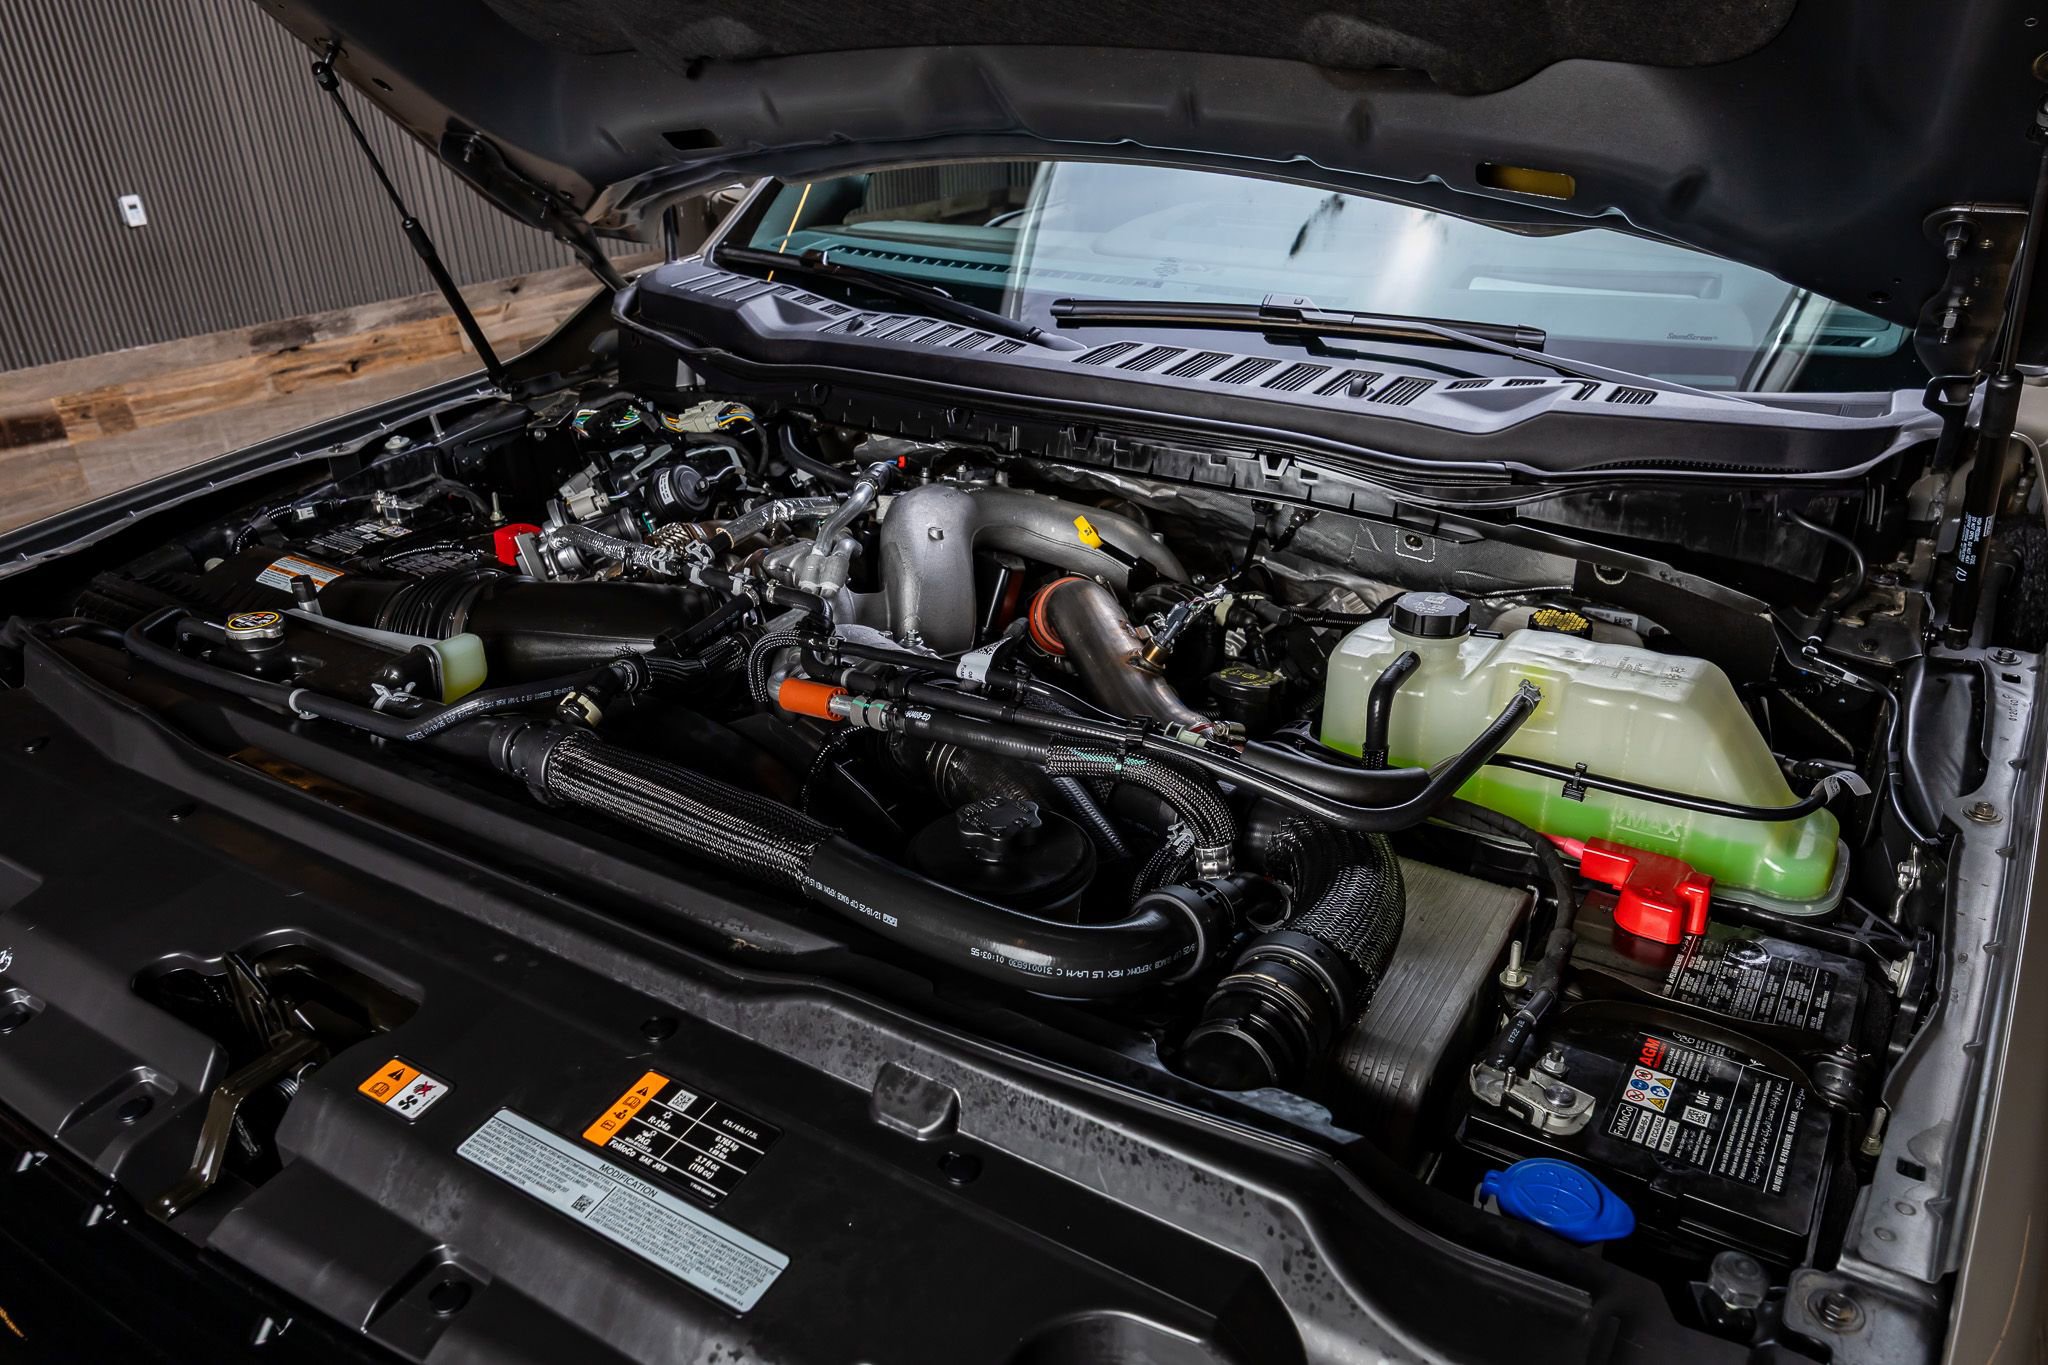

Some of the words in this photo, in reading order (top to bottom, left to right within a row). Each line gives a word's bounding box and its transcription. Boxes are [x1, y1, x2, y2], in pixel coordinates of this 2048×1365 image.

[970, 947, 1004, 963] 01:03:55
[1056, 968, 1062, 976] C
[1639, 1038, 1659, 1065] AGM
[1695, 1090, 1710, 1105] MF
[647, 1116, 671, 1130] R-134a
[1614, 1105, 1633, 1136] FoMoCo
[728, 1142, 740, 1151] kg
[608, 1140, 636, 1156] FoMoCo
[638, 1155, 652, 1165] SAE
[651, 1162, 667, 1173] J639
[694, 1155, 707, 1164] 3.7
[709, 1163, 719, 1171] oz
[687, 1163, 704, 1174] (110
[700, 1169, 714, 1179] cc)
[599, 1164, 657, 1197] MODIFICATION
